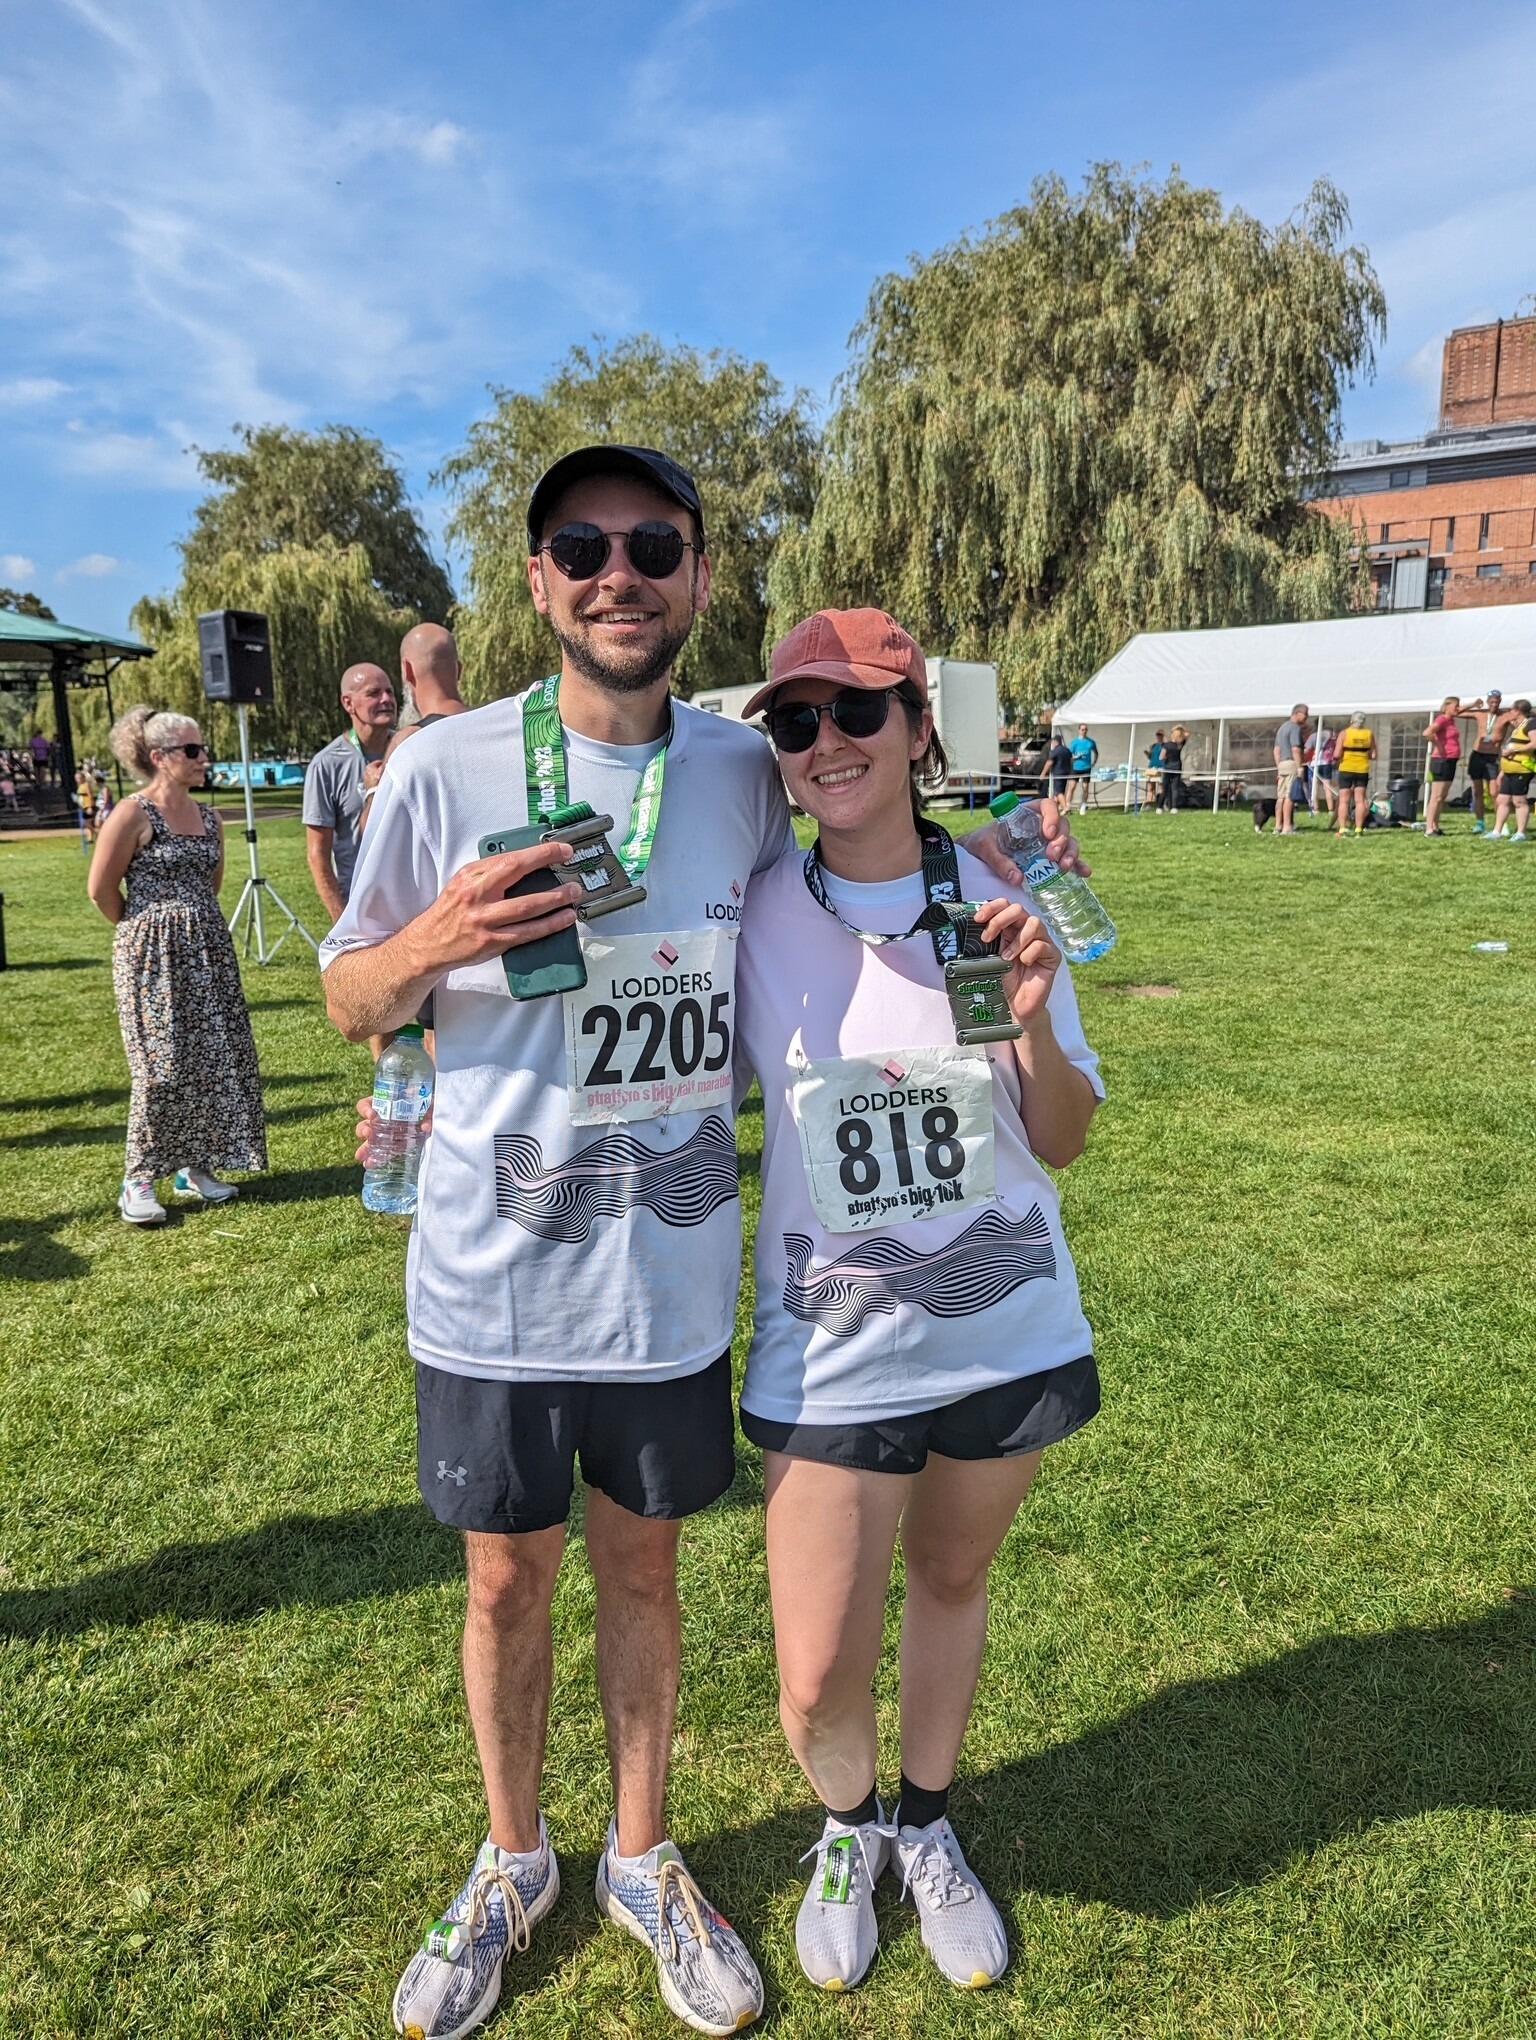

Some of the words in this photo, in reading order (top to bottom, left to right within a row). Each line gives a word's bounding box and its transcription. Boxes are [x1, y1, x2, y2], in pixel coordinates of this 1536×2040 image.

[534, 746, 554, 777] 2023
[611, 971, 713, 1000] LODDERS
[581, 991, 731, 1087] 2205
[651, 1080, 677, 1106] big
[839, 1086, 949, 1117] LODDERS
[835, 1105, 966, 1196] 818
[907, 1185, 932, 1207] big
